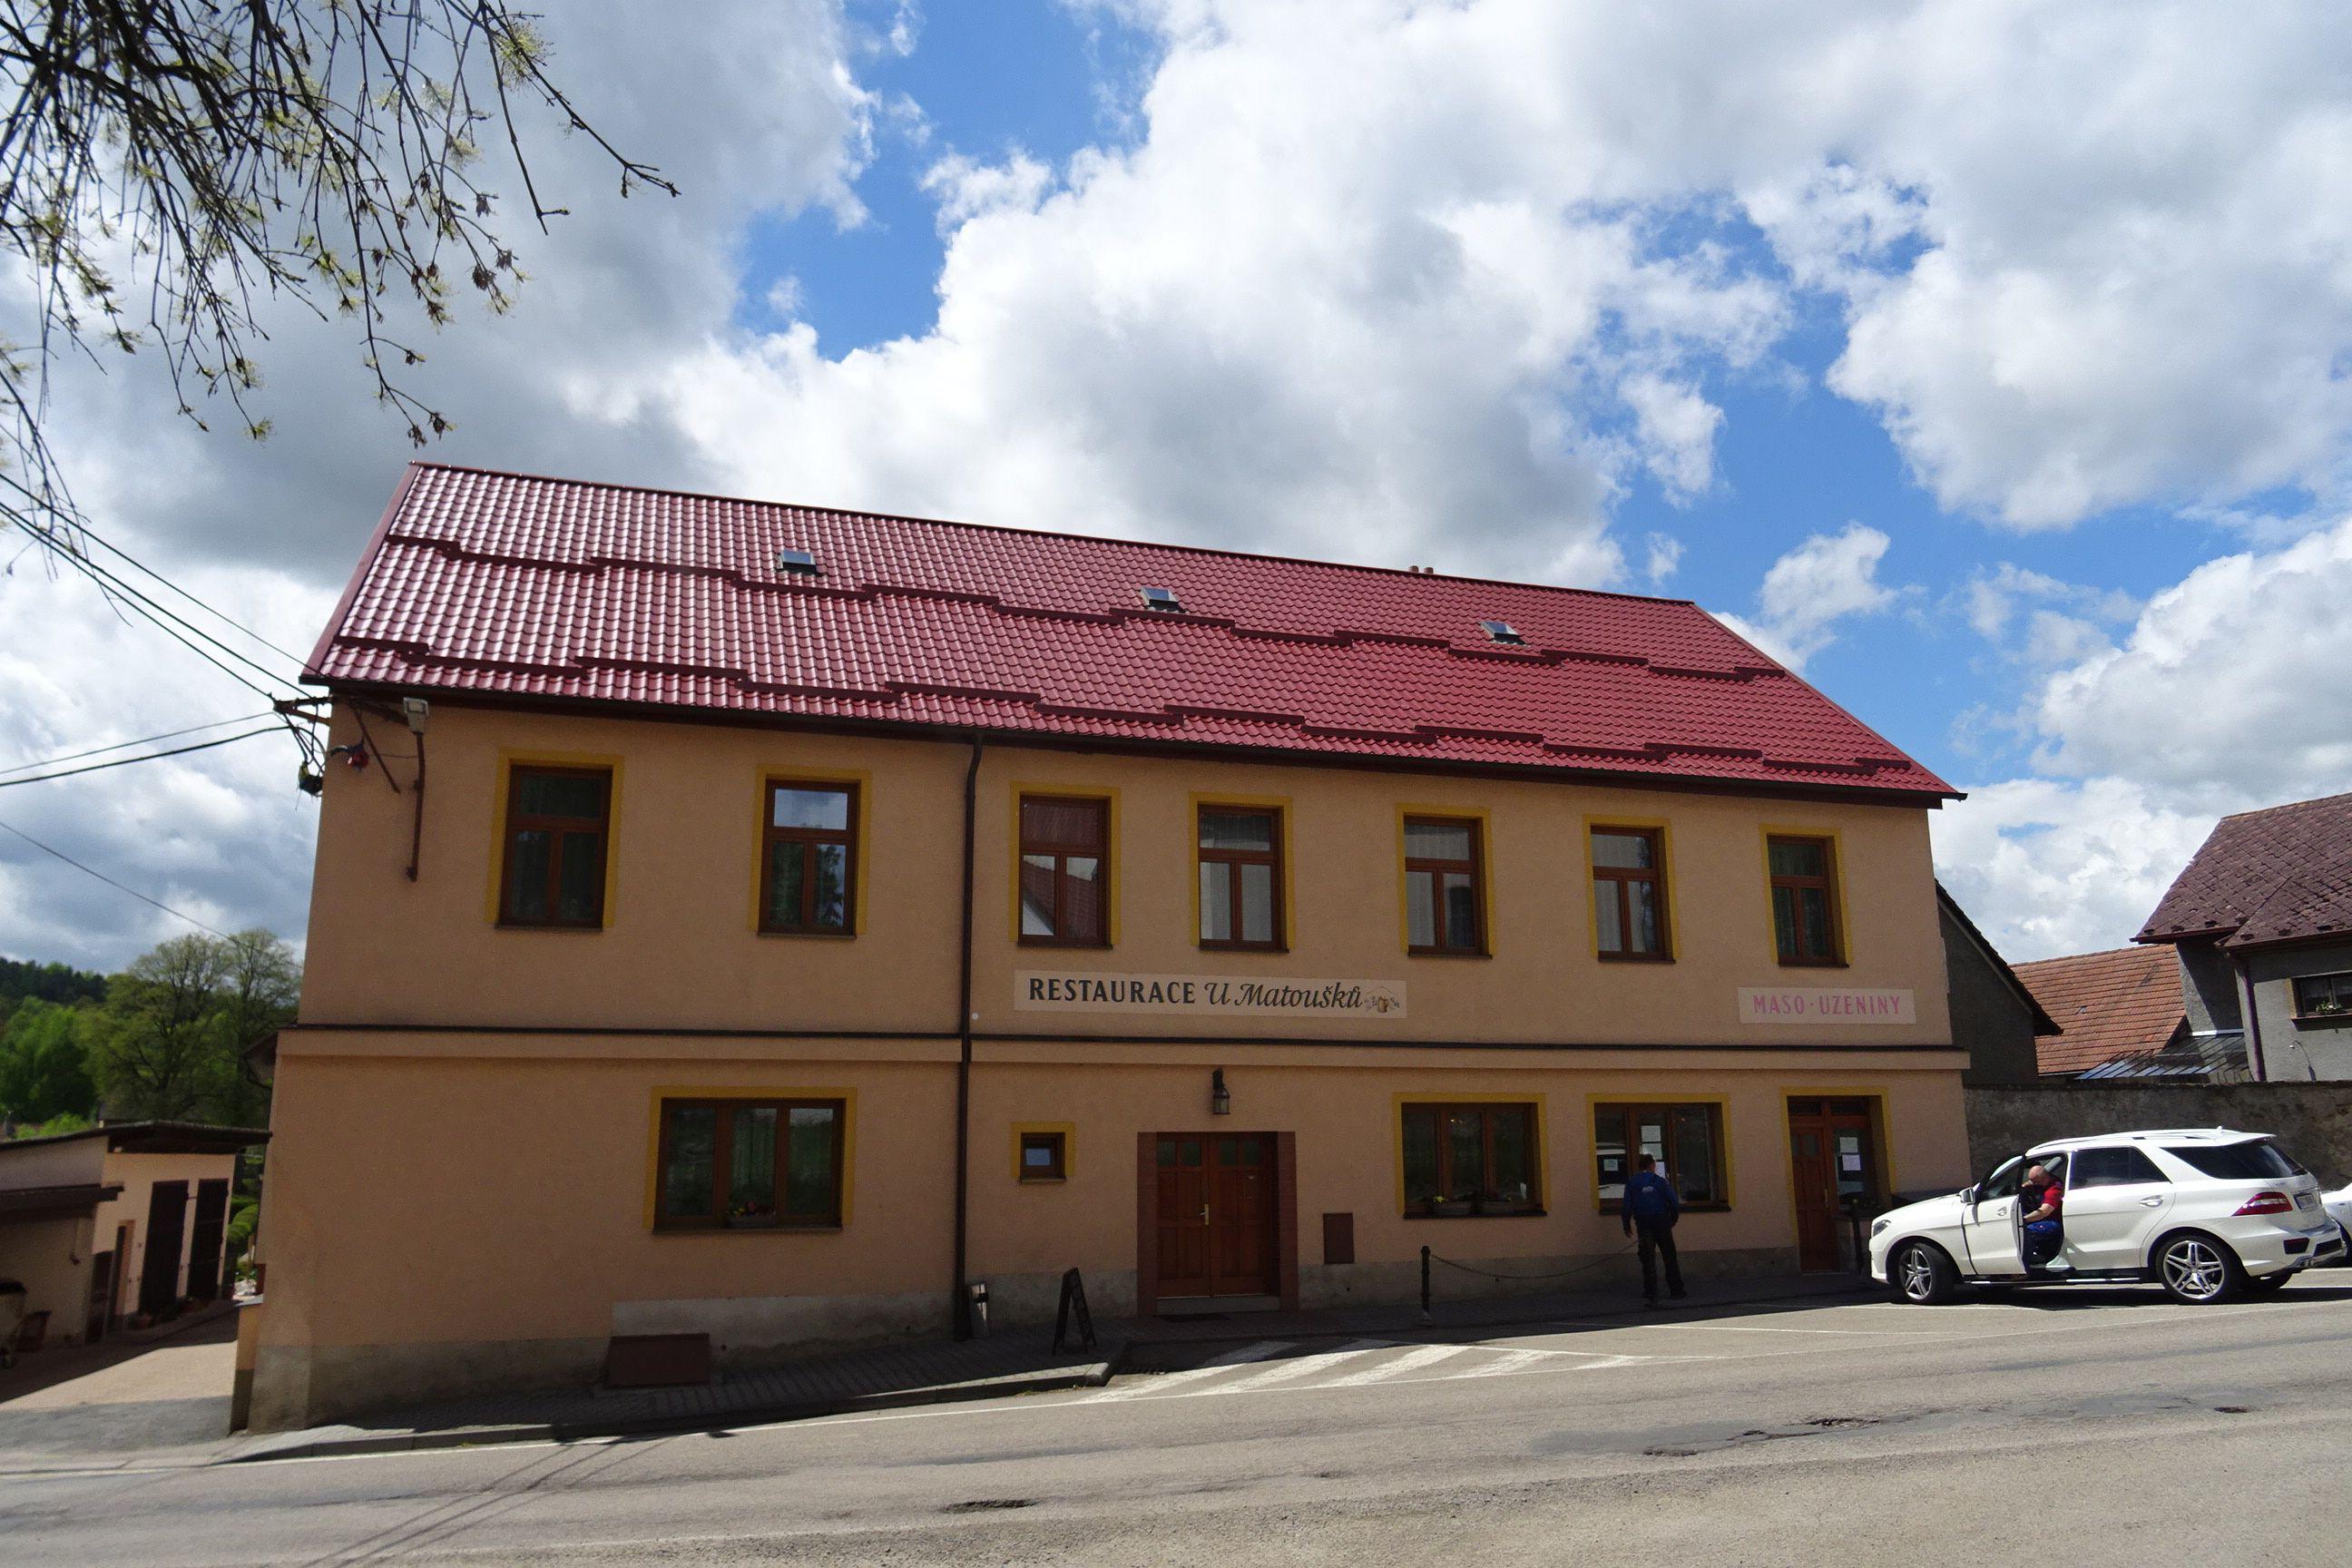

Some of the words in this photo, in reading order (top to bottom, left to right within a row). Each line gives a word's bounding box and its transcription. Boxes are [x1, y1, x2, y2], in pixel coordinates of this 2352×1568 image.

[1029, 977, 1195, 1004] RESTAURACE
[1204, 982, 1230, 1004] U
[1234, 981, 1363, 1008] Matoušků
[1753, 994, 1805, 1014] MASO
[1819, 995, 1901, 1015] UZENINY
